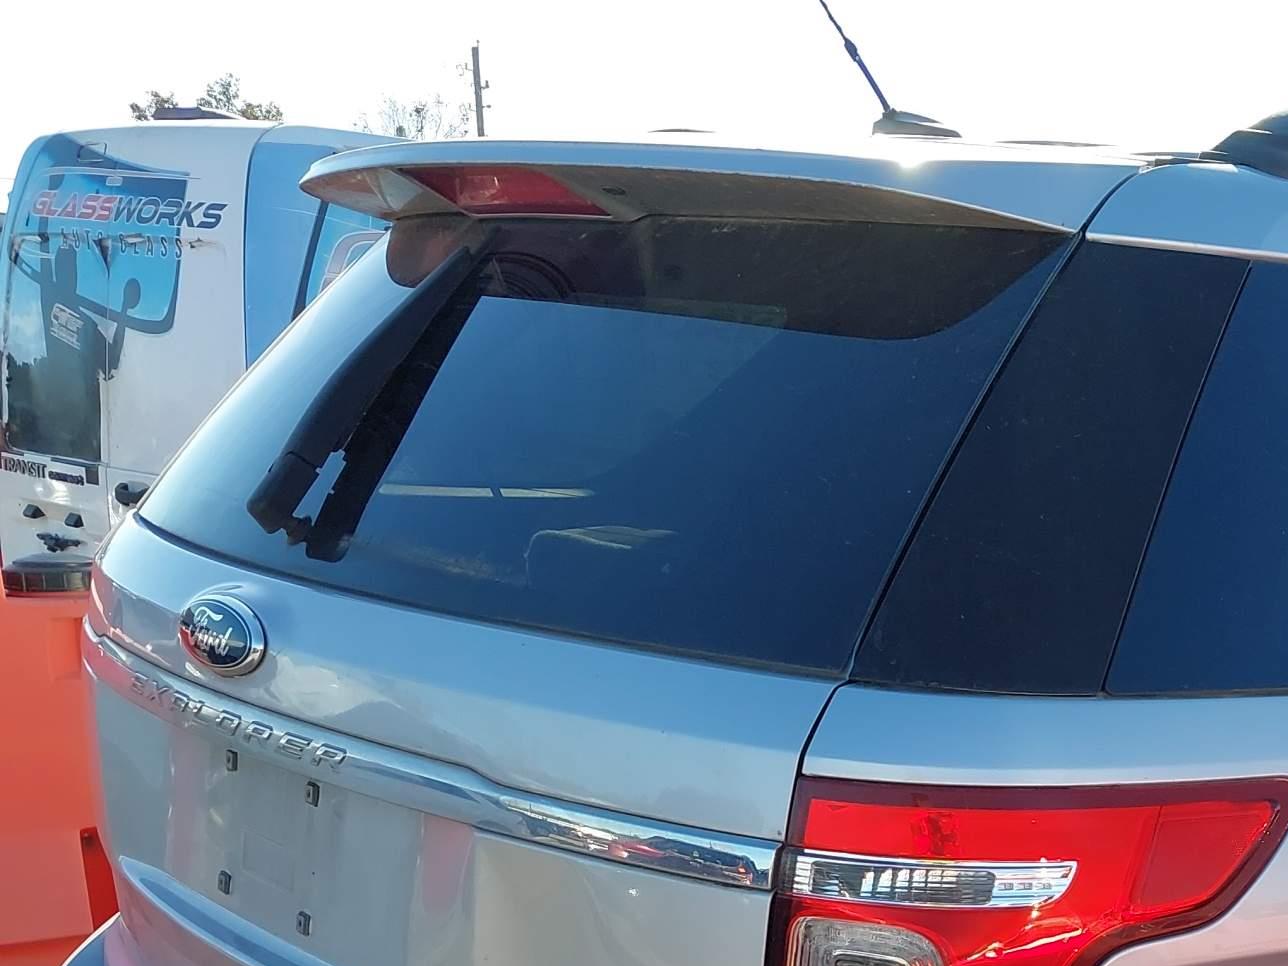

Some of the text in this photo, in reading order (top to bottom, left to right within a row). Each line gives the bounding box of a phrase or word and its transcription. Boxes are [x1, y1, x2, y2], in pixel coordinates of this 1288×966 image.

[32, 189, 229, 230] GLASSWORKS
[2, 456, 48, 479] TRANSIT
[187, 605, 246, 657] Ford
[130, 672, 348, 770] EXPLORER
